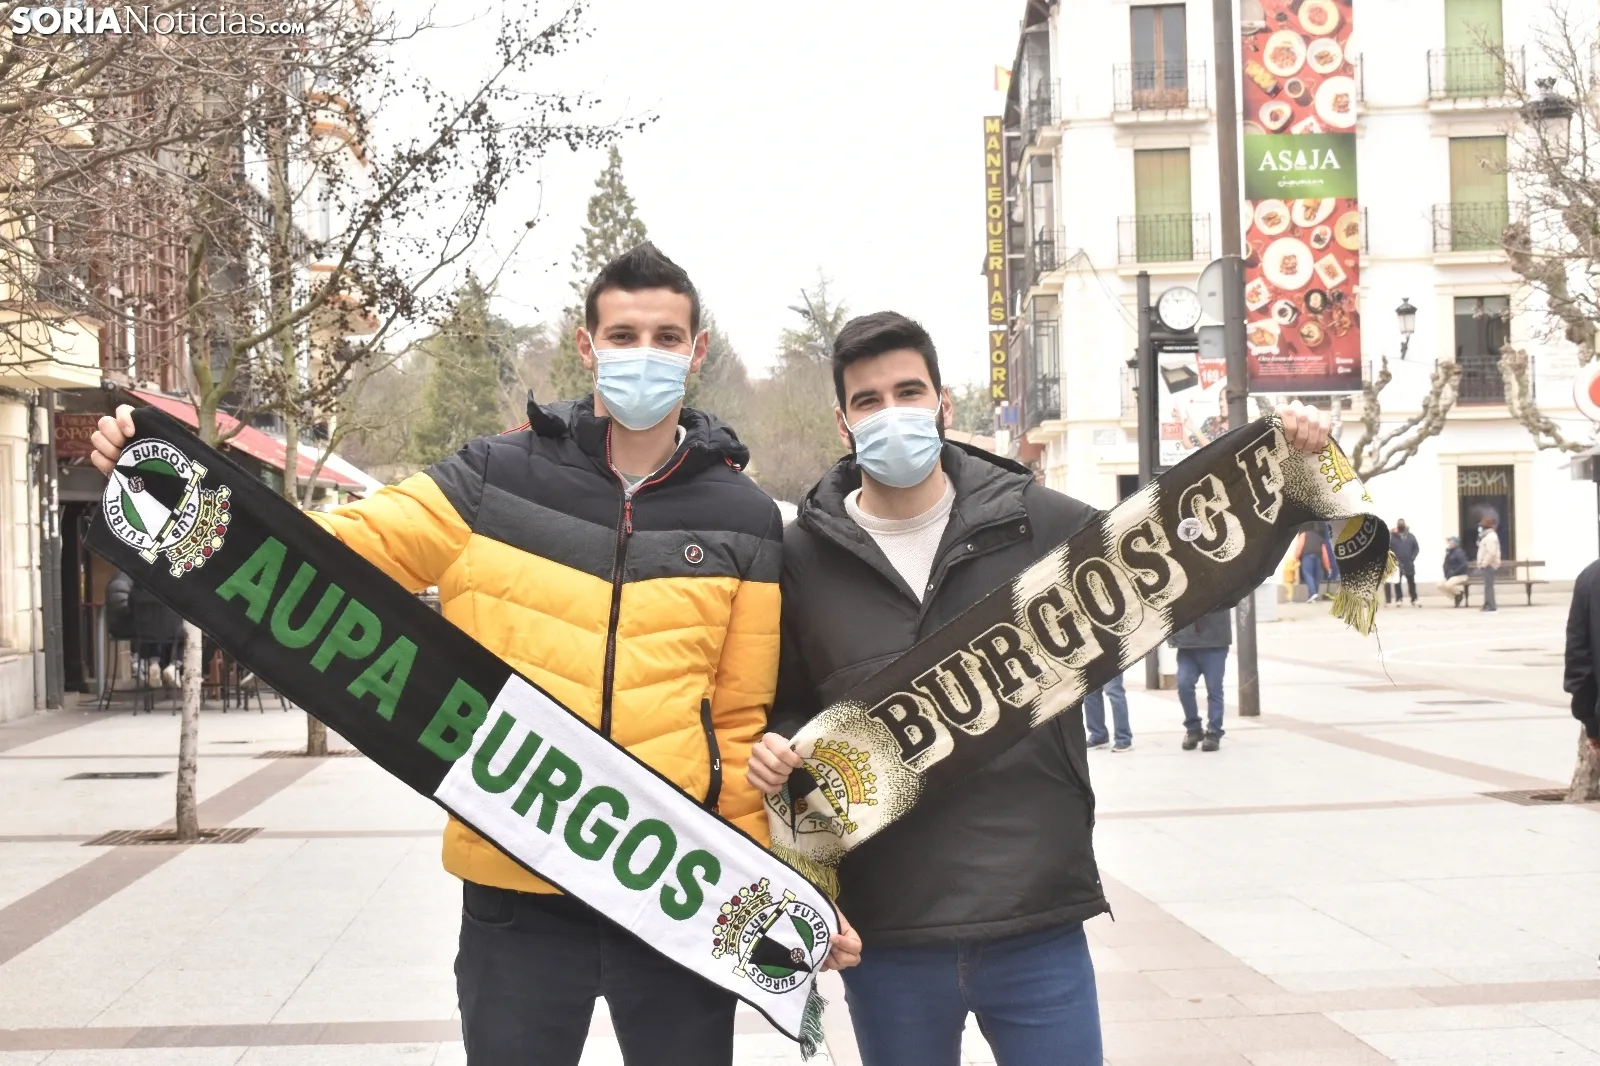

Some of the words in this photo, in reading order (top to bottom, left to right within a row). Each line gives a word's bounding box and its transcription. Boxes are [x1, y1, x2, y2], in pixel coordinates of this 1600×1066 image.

[1258, 148, 1341, 171] ASAJA
[985, 118, 1004, 322] MANTEQUERIAS
[992, 333, 1007, 399] YORK
[133, 444, 189, 474] BURGOS
[1458, 470, 1508, 488] BBVA
[107, 495, 145, 545] FUTBOL
[171, 502, 196, 539] CLUB
[866, 518, 1189, 773] BURGOS
[215, 535, 418, 721] AUPA
[417, 677, 721, 920] BURGOS
[815, 763, 846, 800] CLUB
[742, 912, 768, 944] CLUB
[793, 904, 826, 947] FUTBOL
[750, 966, 796, 990] BURGOS
